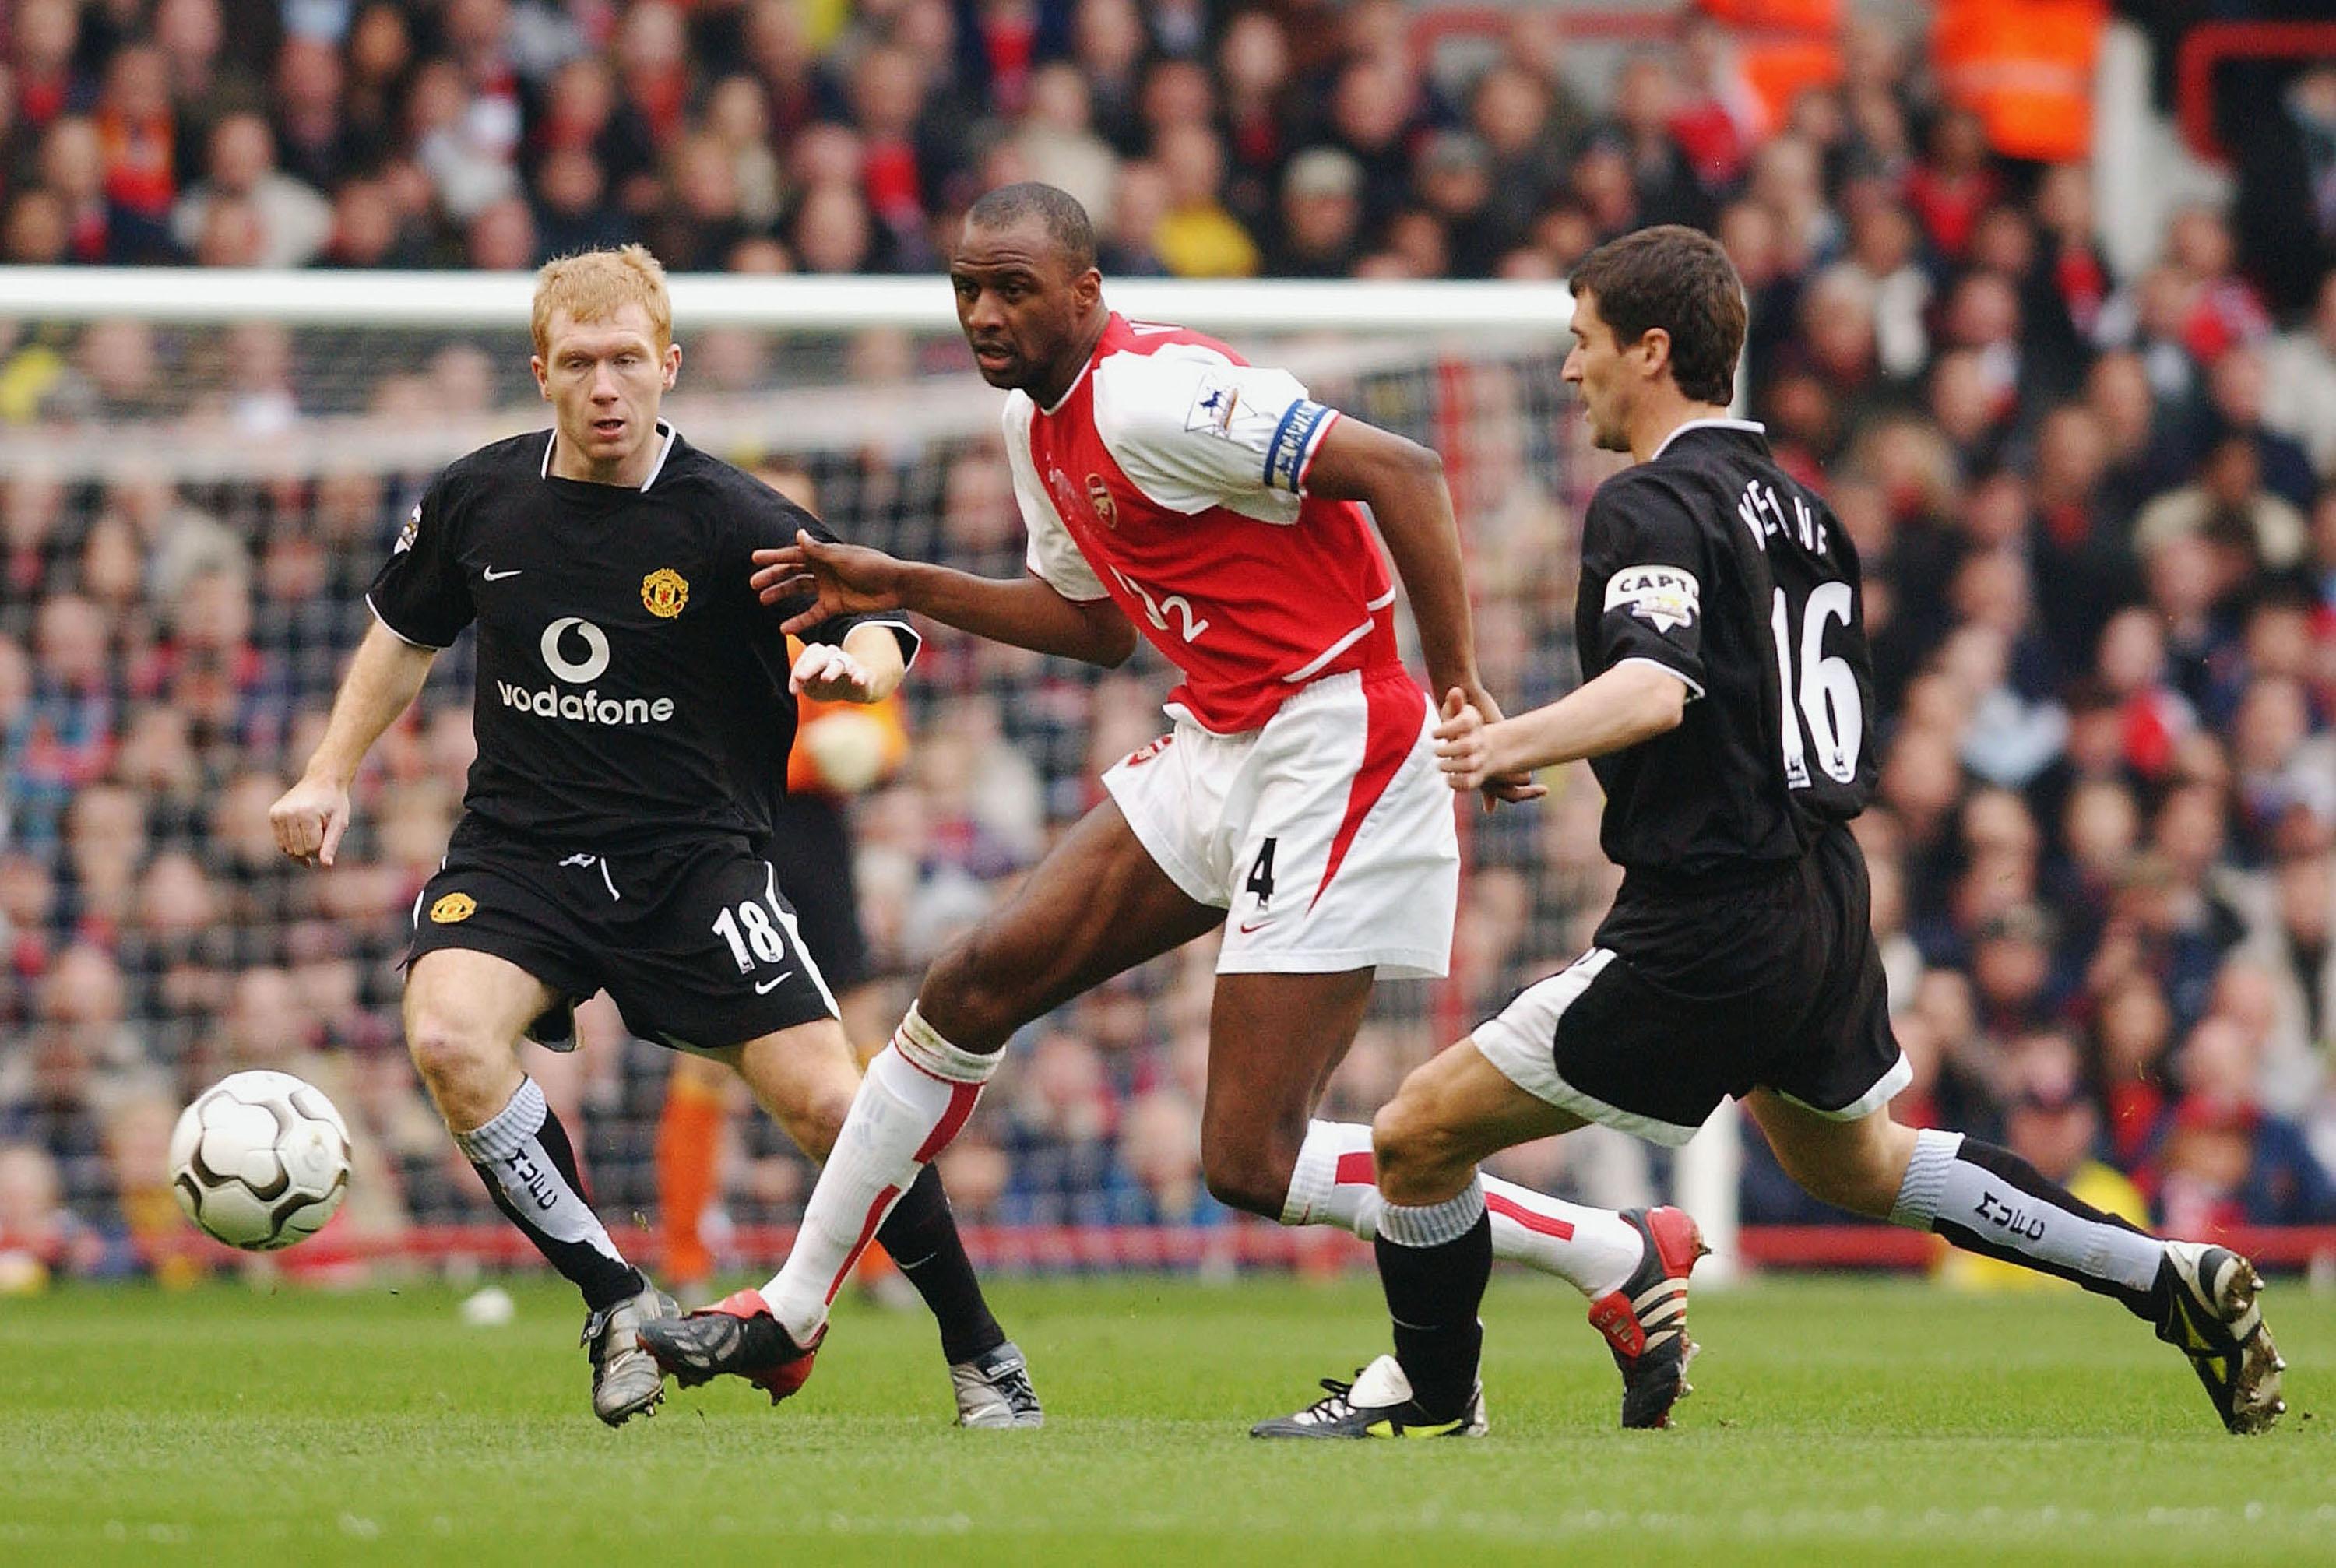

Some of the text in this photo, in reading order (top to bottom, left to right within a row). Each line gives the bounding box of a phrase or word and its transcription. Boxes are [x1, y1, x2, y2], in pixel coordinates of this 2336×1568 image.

[1279, 404, 1319, 452] CAPTA
[497, 680, 675, 726] vodafone
[1771, 581, 1863, 790] 16
[1246, 837, 1278, 911] 4
[712, 900, 786, 975] 18
[505, 1147, 558, 1211] MUFC
[1975, 1190, 2046, 1241] MUFC
